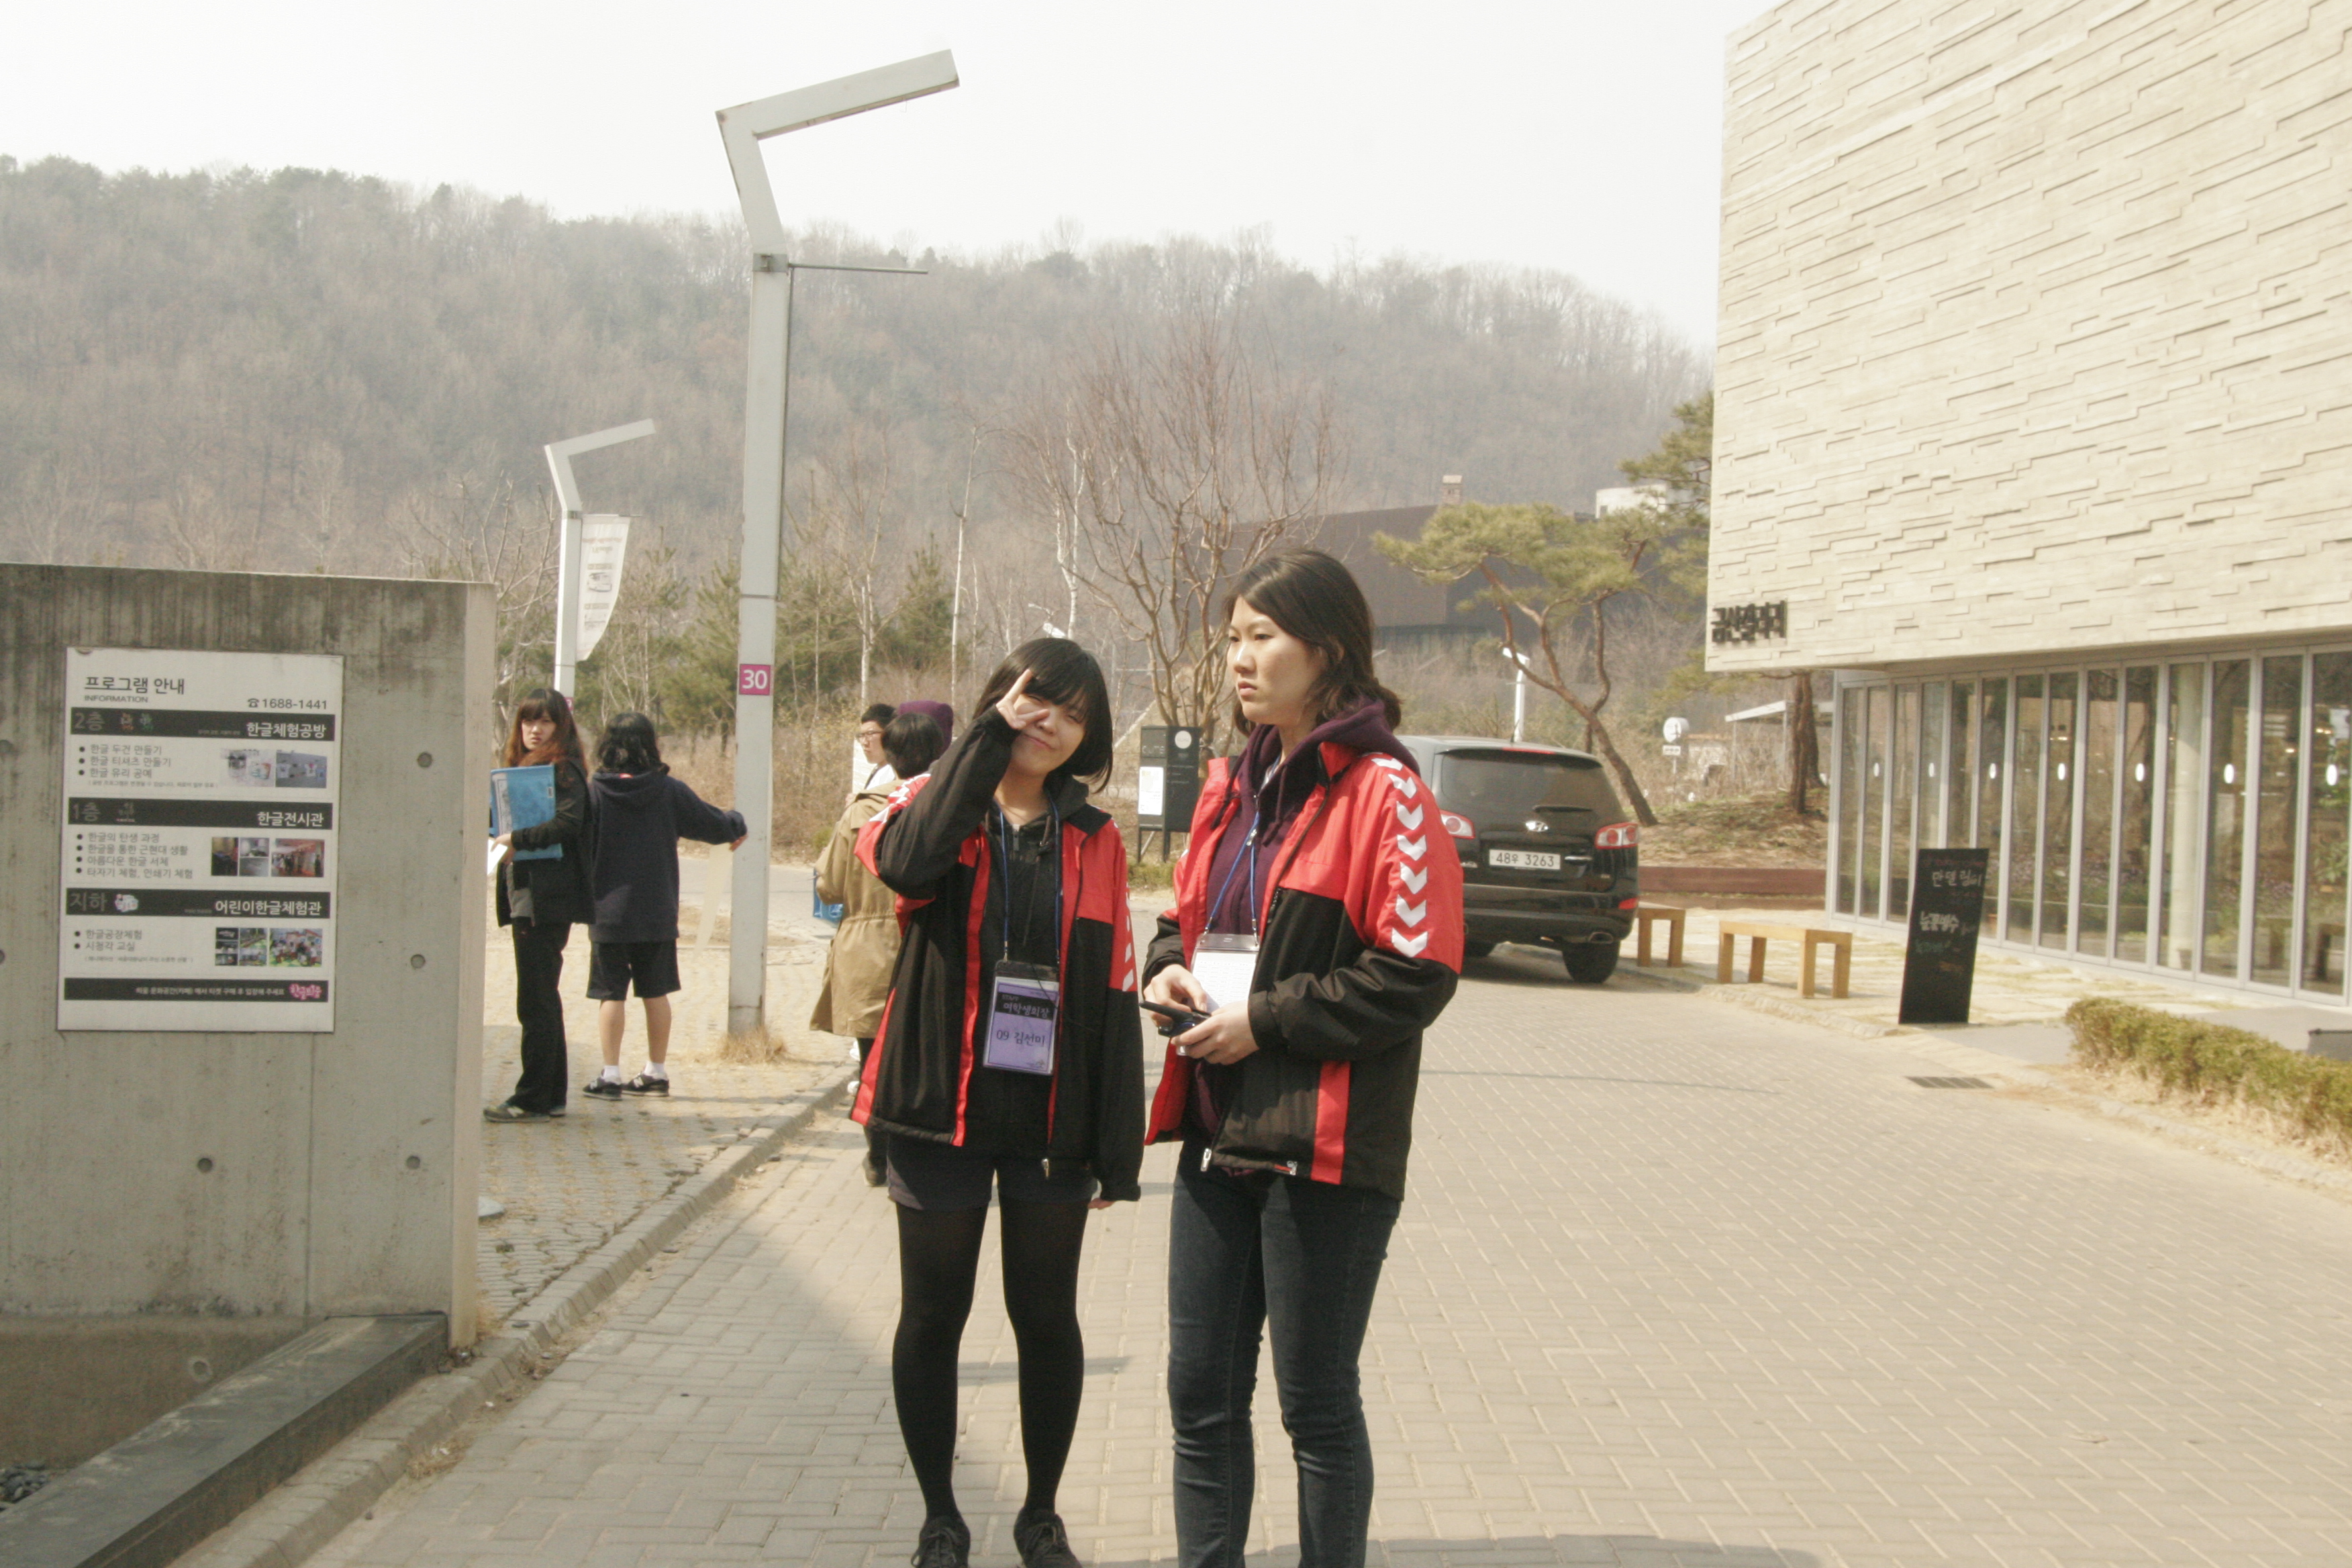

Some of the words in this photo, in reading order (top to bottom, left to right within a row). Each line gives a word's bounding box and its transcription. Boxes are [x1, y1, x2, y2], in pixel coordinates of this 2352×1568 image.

[85, 677, 148, 694] 프로그램
[154, 678, 185, 695] 안내
[742, 670, 768, 690] 30
[85, 695, 148, 703] INFORMATION
[262, 698, 328, 709] 1688-1441
[75, 712, 105, 731] 2층
[246, 722, 326, 738] 한글체험공방
[91, 744, 108, 754] 한글
[134, 745, 162, 754] 만들기
[90, 756, 108, 766] 한글
[112, 757, 140, 766] 티셔츠
[144, 758, 171, 767] 만들기
[90, 769, 108, 778] 한글
[112, 769, 130, 778] 유리
[134, 769, 152, 778] 공예
[73, 802, 101, 822] 1층
[257, 812, 324, 828] 한글전시관
[88, 833, 115, 842] 한글의
[119, 834, 137, 843] 탄생
[142, 834, 159, 843] 과정
[88, 844, 115, 854] 한글을
[119, 845, 136, 854] 통한
[140, 846, 167, 855] 근현대
[171, 846, 188, 856] 생활
[88, 856, 124, 866] 아름다운
[129, 857, 146, 866] 한글
[150, 857, 168, 866] 서체
[1496, 852, 1518, 864] 48우
[1525, 854, 1554, 867] 3263
[87, 869, 115, 877] 타자기
[175, 869, 193, 879] 체험
[71, 893, 107, 912] 지하
[215, 899, 322, 916] 어린이한글체험관
[85, 942, 113, 951] 시청각
[117, 942, 134, 952] 교실
[1003, 1003, 1050, 1018] 여학생회장
[996, 1030, 1010, 1040] 09
[1014, 1032, 1045, 1047] 김선미
